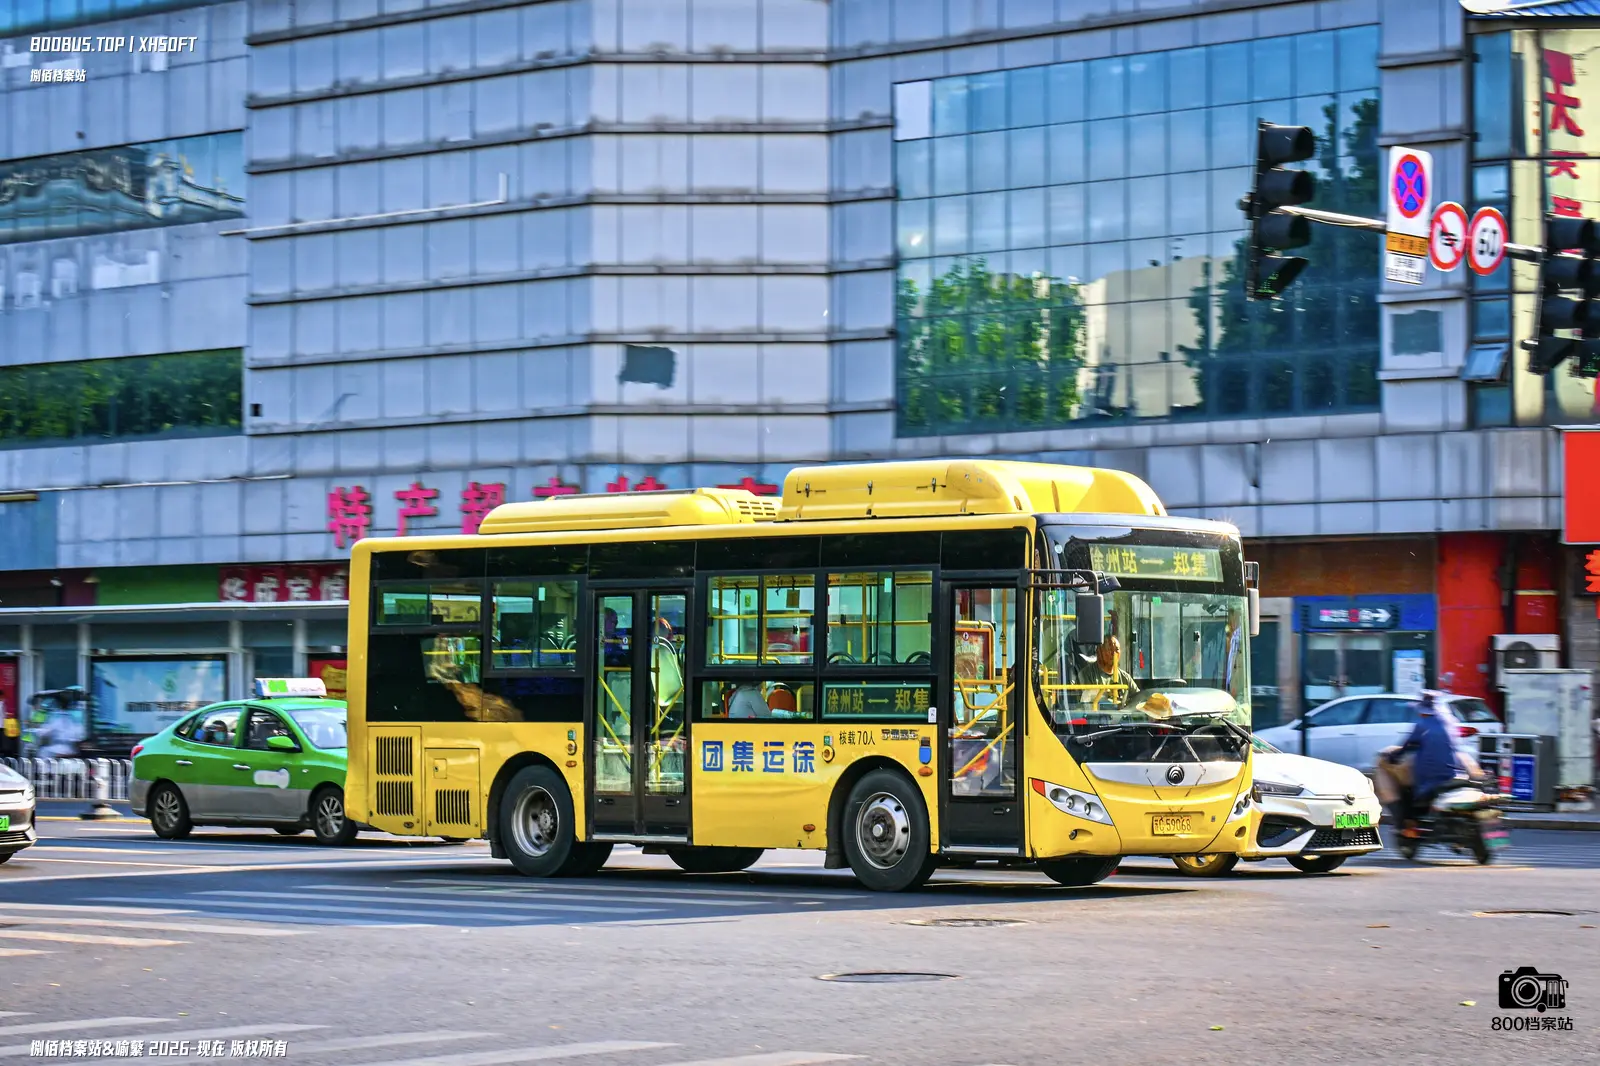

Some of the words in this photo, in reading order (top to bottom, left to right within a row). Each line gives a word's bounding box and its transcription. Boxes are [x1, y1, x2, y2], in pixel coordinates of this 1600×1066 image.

[1091, 546, 1138, 574] 徐州站
[1173, 551, 1208, 576] 郑集
[827, 688, 864, 713] 徐州站
[895, 688, 929, 713] 郑集
[839, 730, 876, 746] 核载70人
